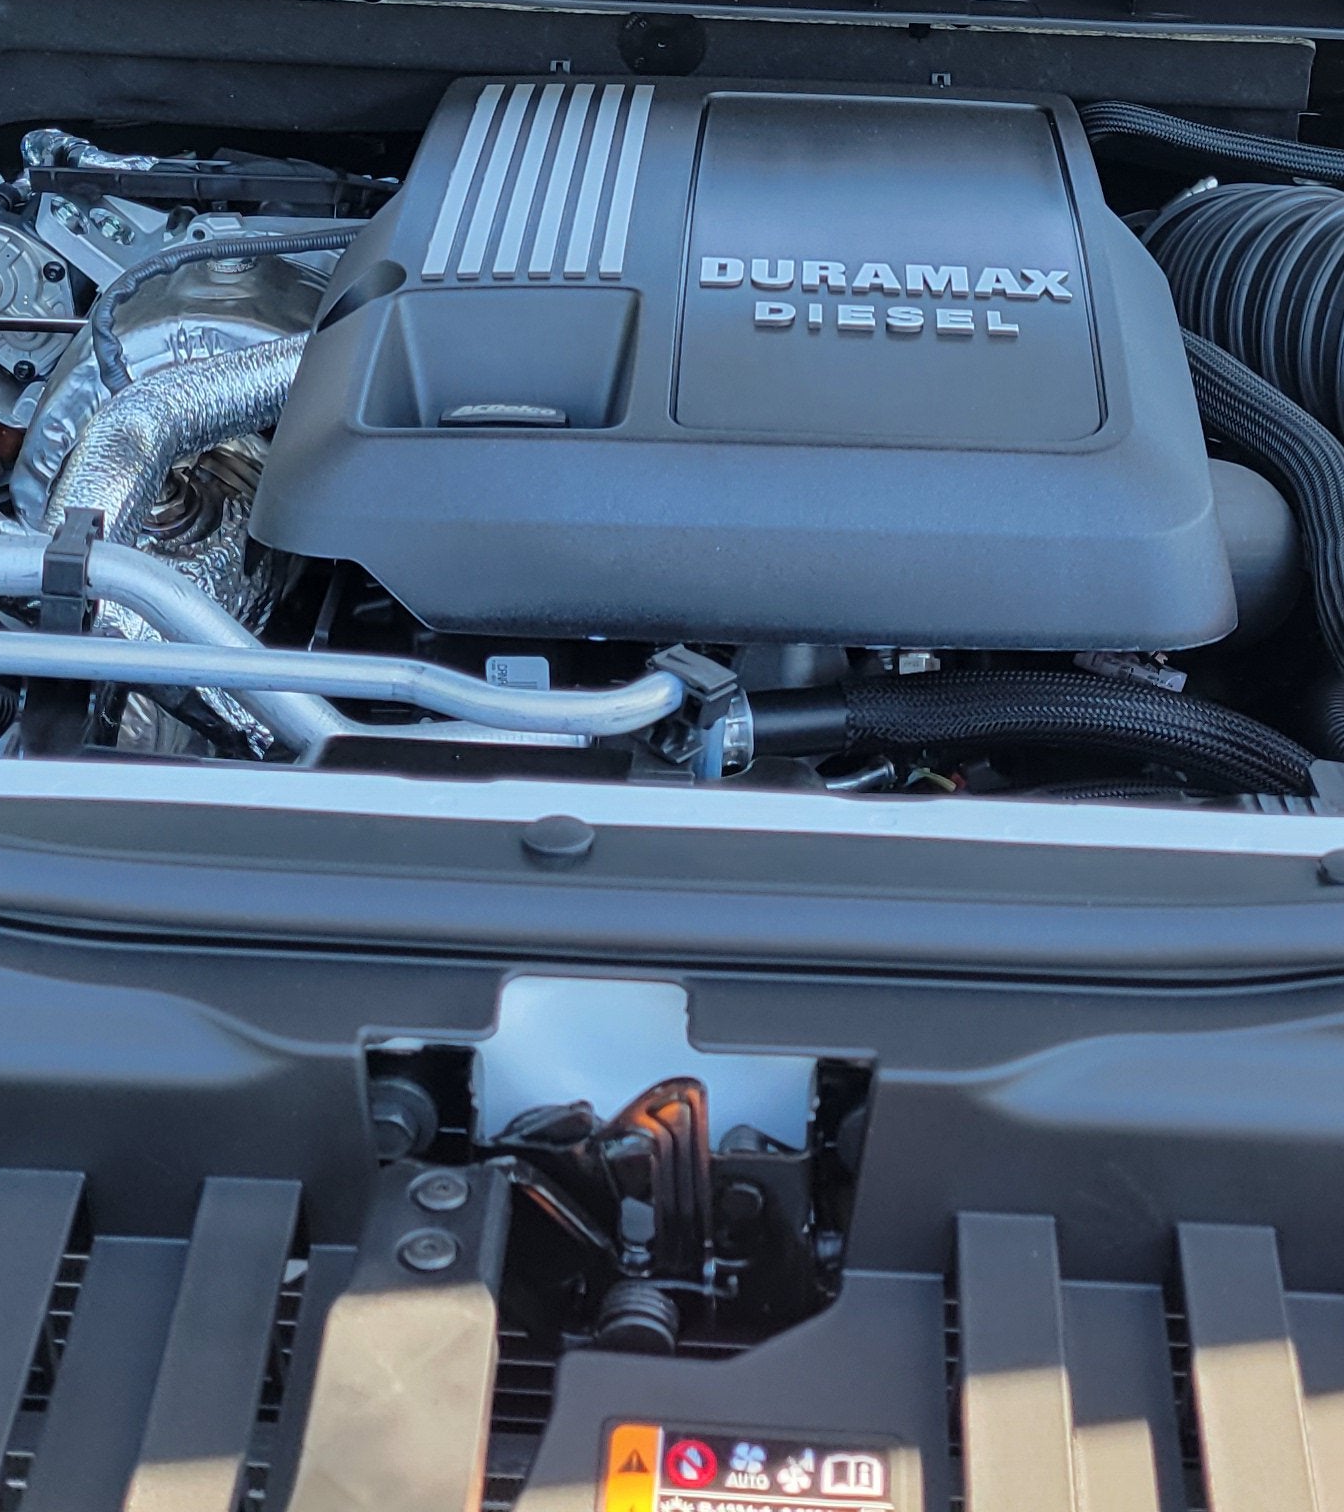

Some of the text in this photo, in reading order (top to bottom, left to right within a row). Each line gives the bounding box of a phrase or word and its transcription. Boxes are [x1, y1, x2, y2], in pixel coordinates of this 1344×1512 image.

[700, 256, 1073, 301] DURAMAX
[754, 301, 1019, 337] DIESEL
[725, 1471, 770, 1491] AUTO
